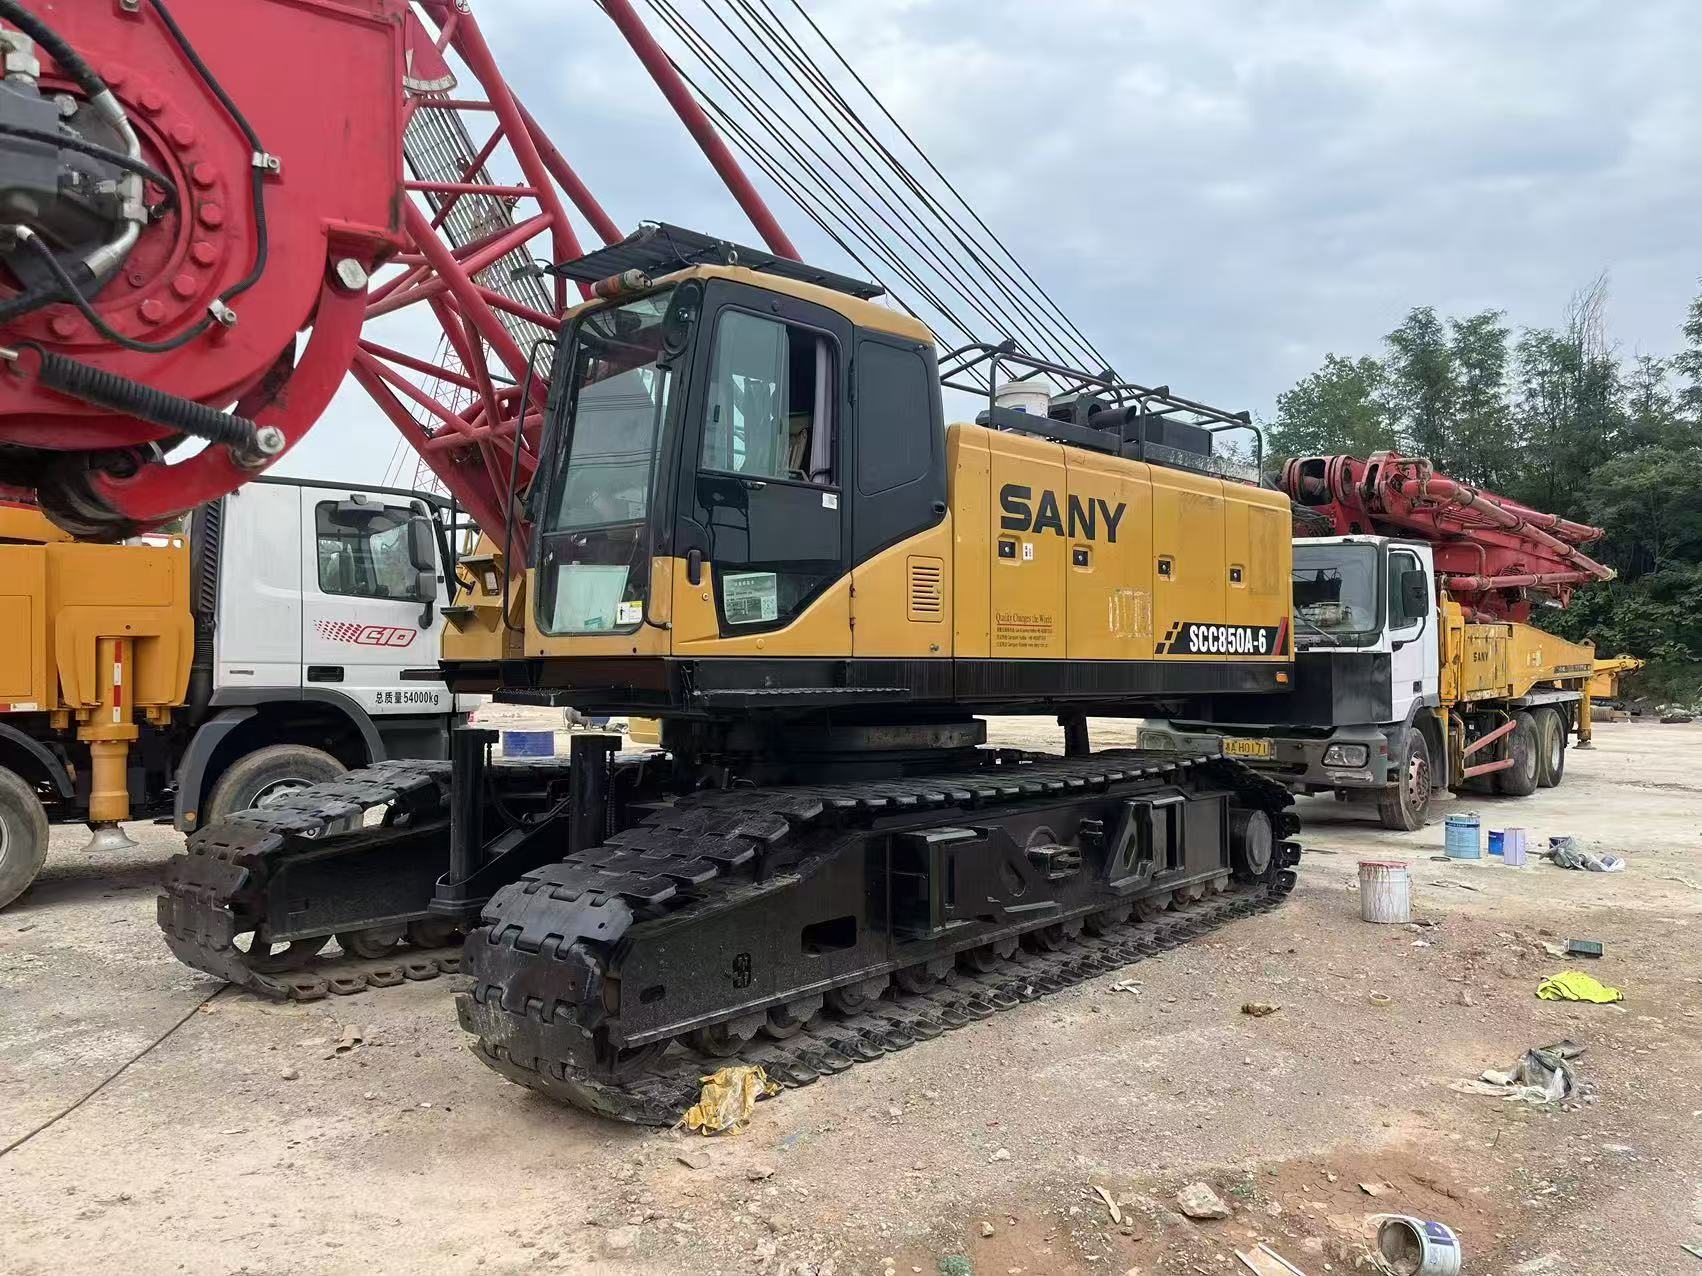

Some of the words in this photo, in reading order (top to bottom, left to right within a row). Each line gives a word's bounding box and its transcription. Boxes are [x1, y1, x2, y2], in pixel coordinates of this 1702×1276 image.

[1000, 483, 1127, 543] SANY
[1189, 624, 1267, 653] SCC850A-6
[1473, 651, 1489, 663] SANY
